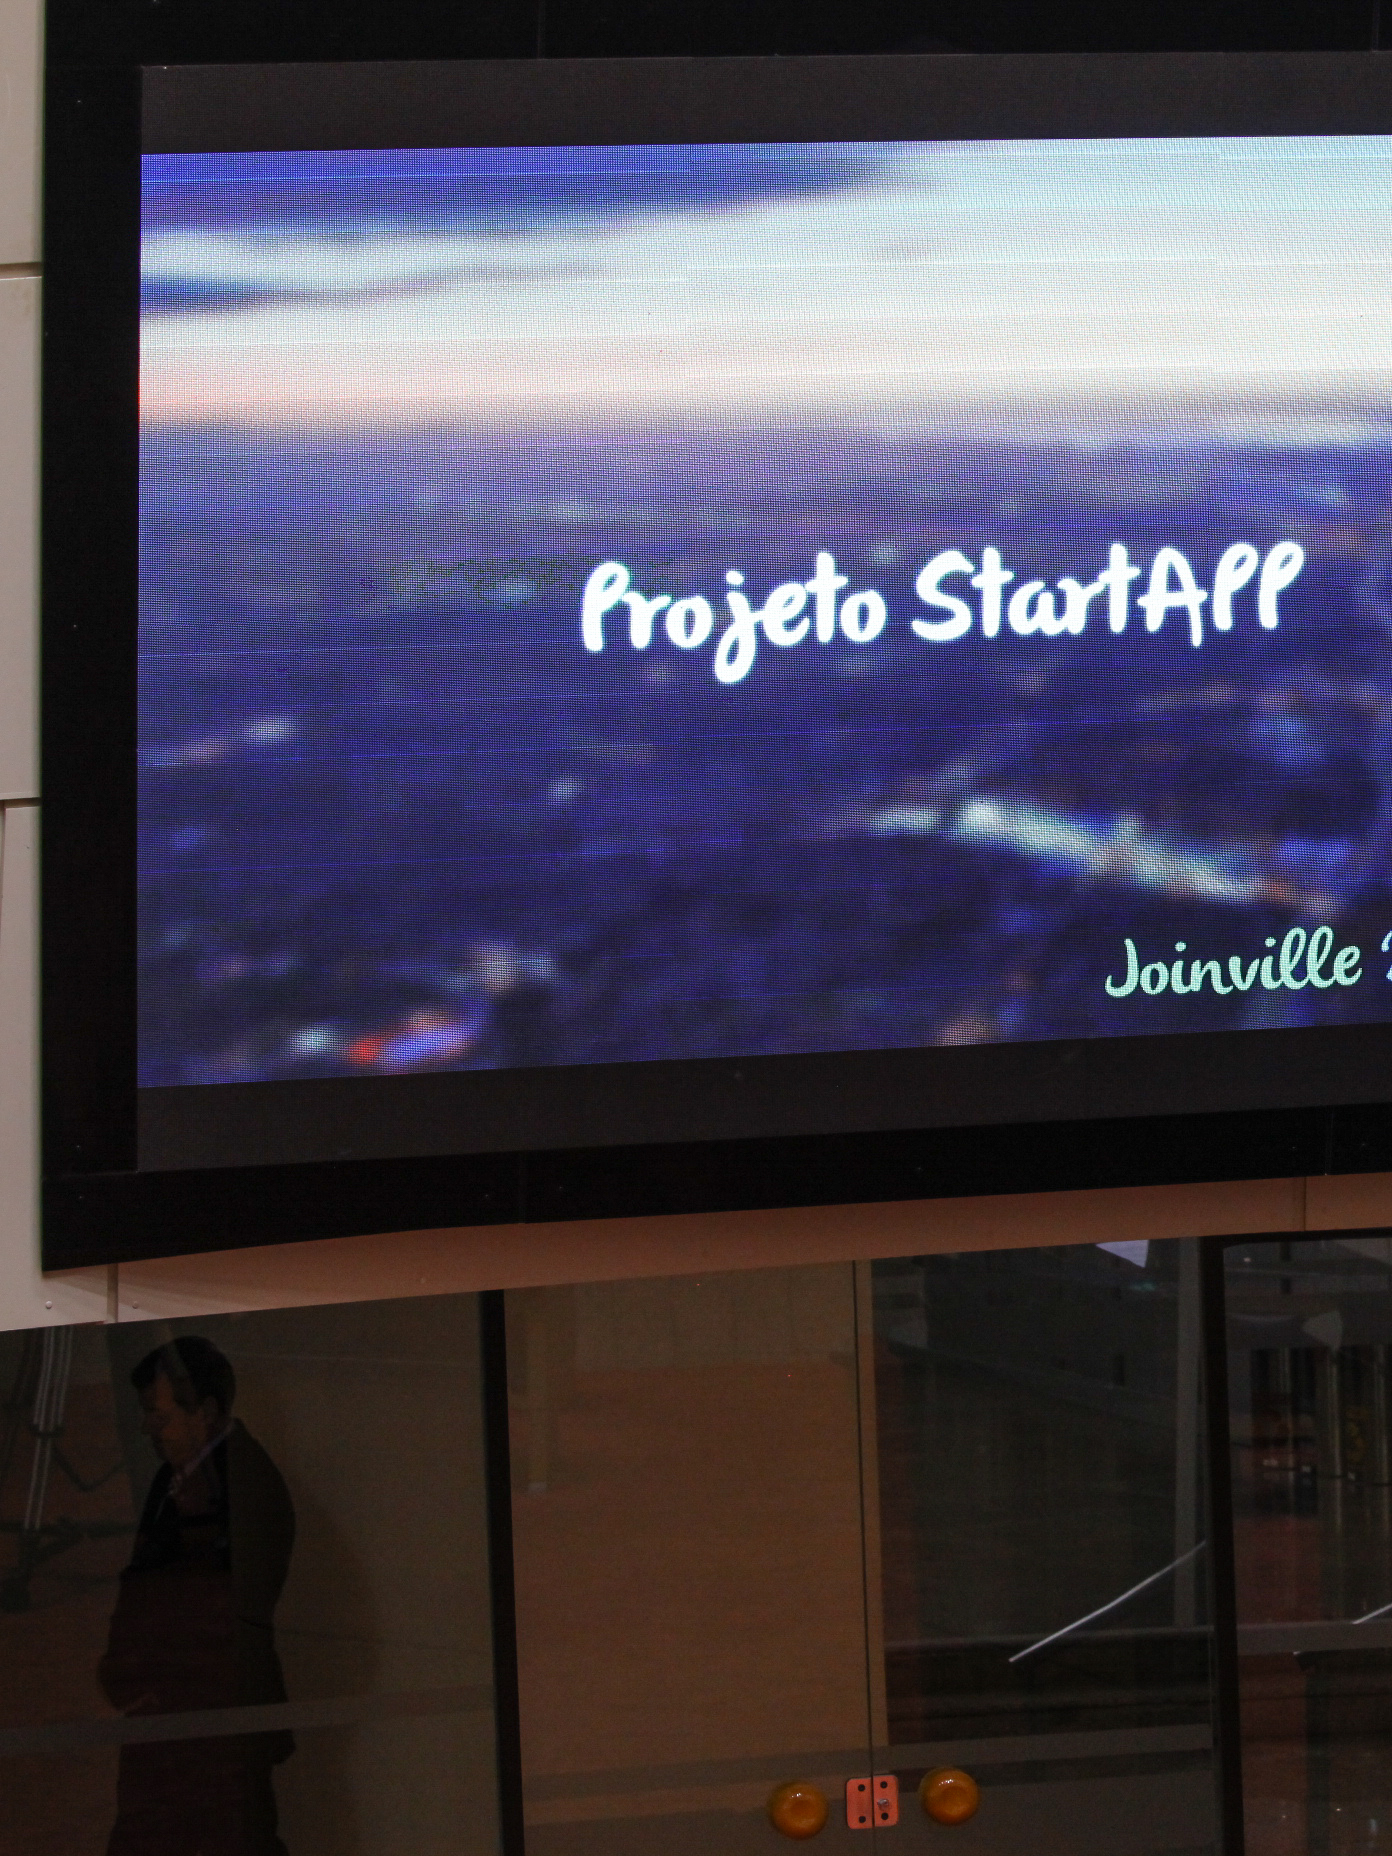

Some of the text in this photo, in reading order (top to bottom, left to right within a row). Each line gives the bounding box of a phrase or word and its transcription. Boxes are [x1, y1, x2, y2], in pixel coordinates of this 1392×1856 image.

[581, 541, 1305, 684] Projeto StartAPP
[1105, 925, 1361, 997] Joinville
